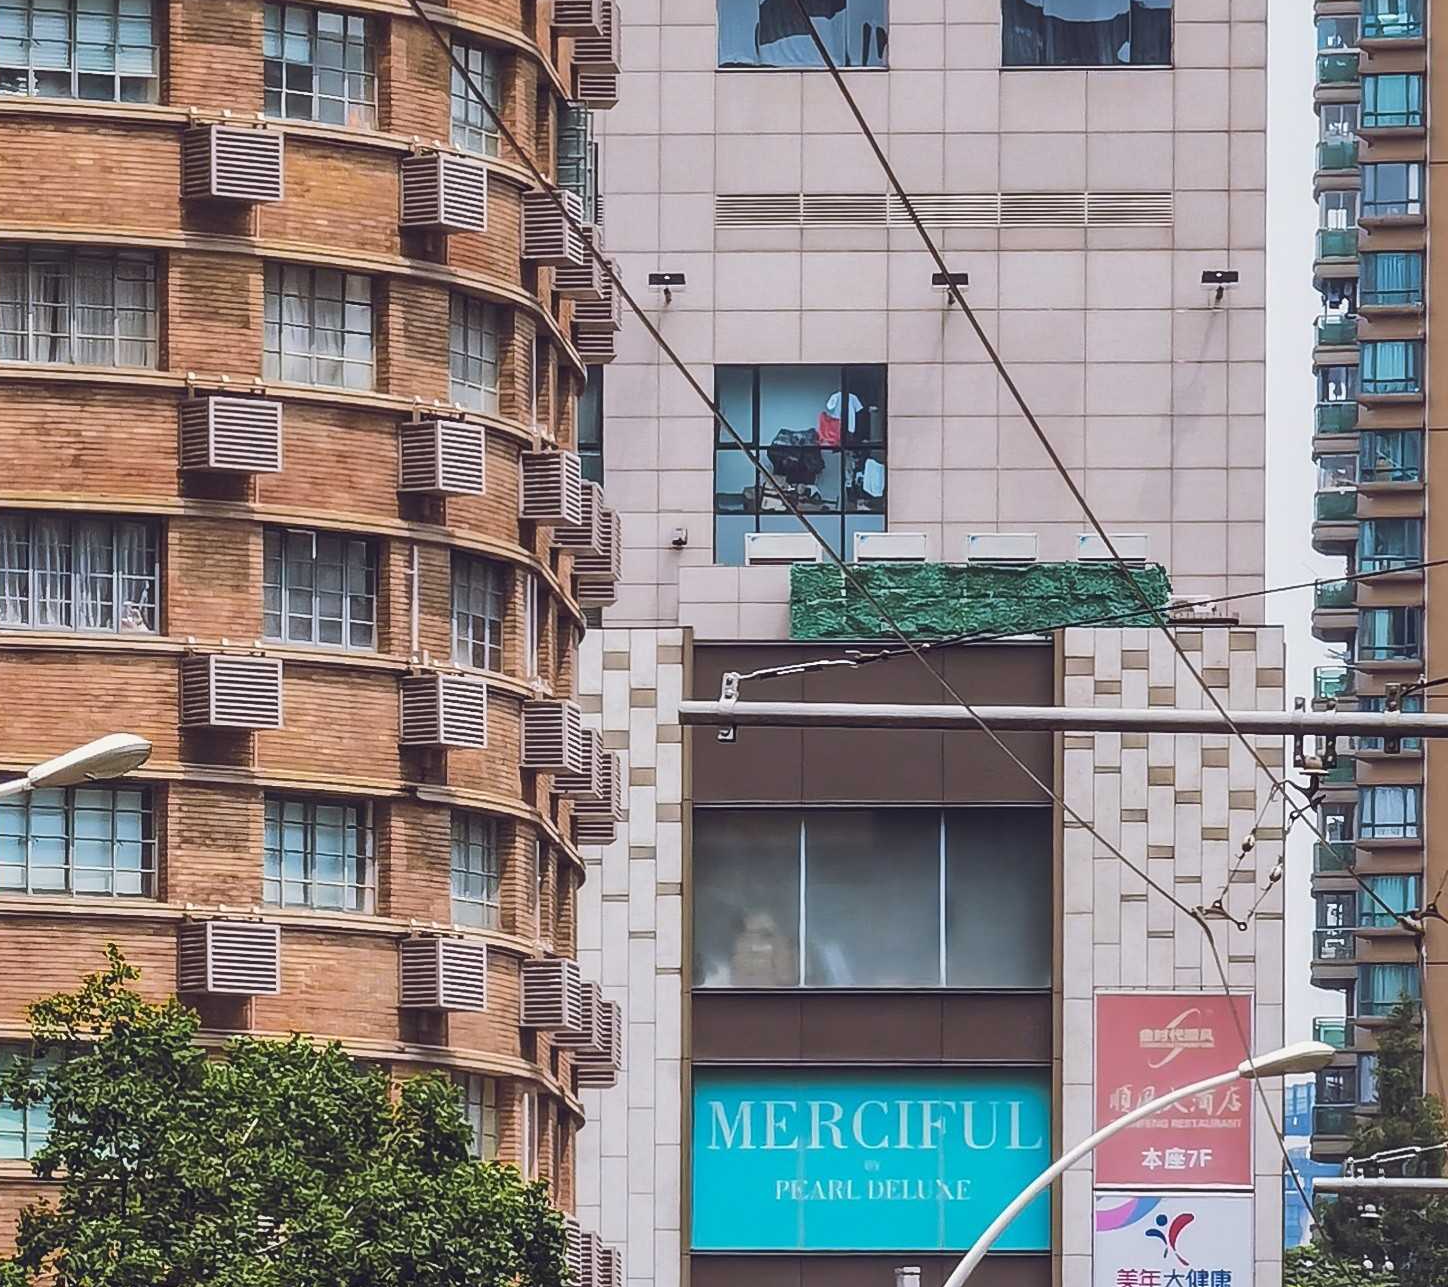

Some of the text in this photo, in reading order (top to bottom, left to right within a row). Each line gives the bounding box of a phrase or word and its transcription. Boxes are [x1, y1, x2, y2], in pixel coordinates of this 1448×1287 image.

[706, 1100, 1042, 1150] MERCIFUL
[1141, 1147, 1213, 1169] 本座7F
[775, 1179, 971, 1200] PEARL DELUXE
